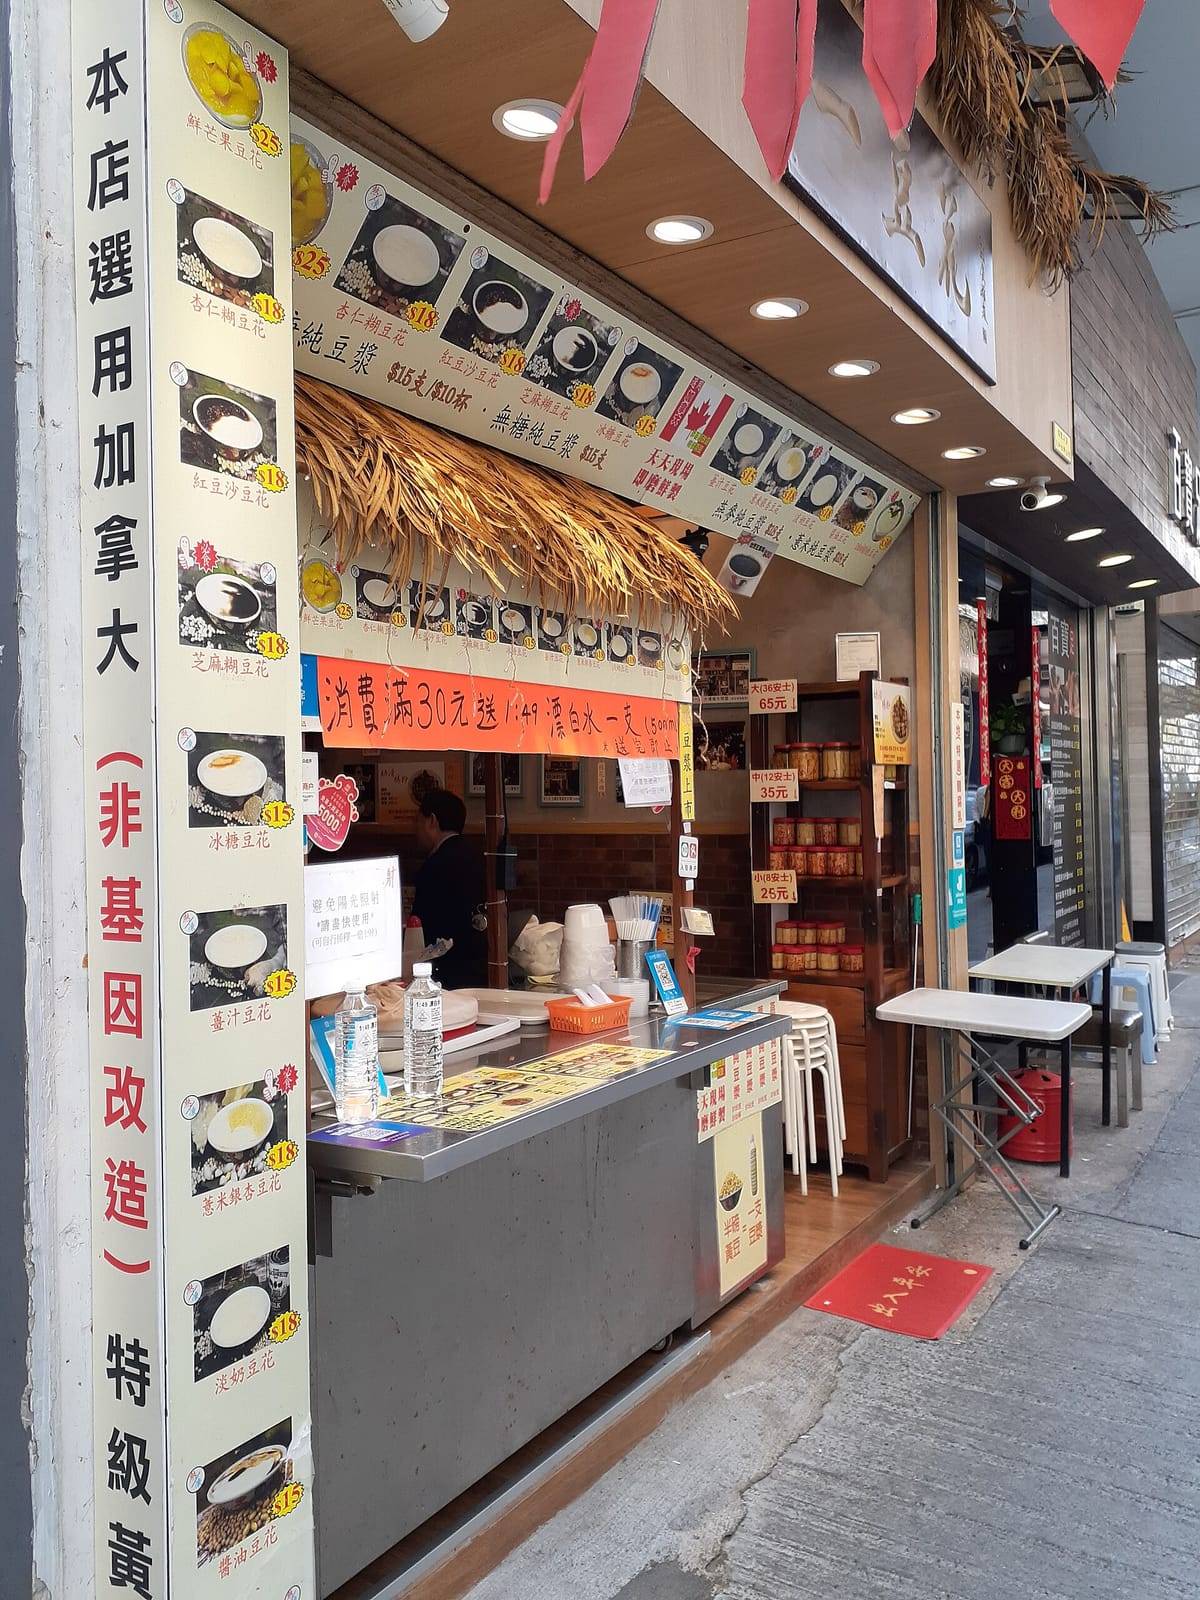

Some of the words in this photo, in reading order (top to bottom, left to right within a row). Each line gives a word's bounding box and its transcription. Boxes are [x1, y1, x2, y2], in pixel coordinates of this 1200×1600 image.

[186, 111, 264, 170] 鮮芒果豆花
[252, 127, 279, 153] $25
[293, 249, 327, 275] $25
[189, 293, 266, 339] 杏仁糊豆花
[255, 298, 282, 321] $18
[407, 302, 438, 329] $18
[335, 301, 409, 347] 杏仁糊豆花
[440, 349, 502, 389] 紅豆沙豆花
[500, 350, 526, 374] $18
[519, 386, 572, 421] 芝麻糊豆花
[572, 384, 595, 406] $18
[386, 361, 473, 413] $15支/$10杯
[489, 403, 580, 460] 無糖純豆漿
[636, 417, 656, 435] $15
[192, 471, 270, 509] 紅豆沙豆花
[258, 468, 286, 489] $18
[336, 604, 351, 617] $25
[258, 635, 286, 655] $18
[191, 651, 270, 678] 芝麻糊豆花
[750, 682, 795, 695] 大(36安士)
[759, 696, 787, 710] 65元
[751, 772, 796, 783] 中(12安士)
[760, 785, 789, 799] 35元
[263, 804, 292, 824] $15
[208, 829, 271, 851] 冰糖豆花
[753, 872, 793, 883] 小(8安士)
[760, 886, 789, 900] 25元
[266, 973, 294, 994] $15
[210, 1001, 273, 1033] 薑汁豆花
[269, 1143, 296, 1168] $18
[202, 1172, 282, 1217] 薏米銀杏豆花
[270, 1312, 298, 1340] $18
[214, 1349, 276, 1395] 淡奶豆花
[274, 1482, 302, 1513] $15
[218, 1525, 279, 1580] 醬油豆花
